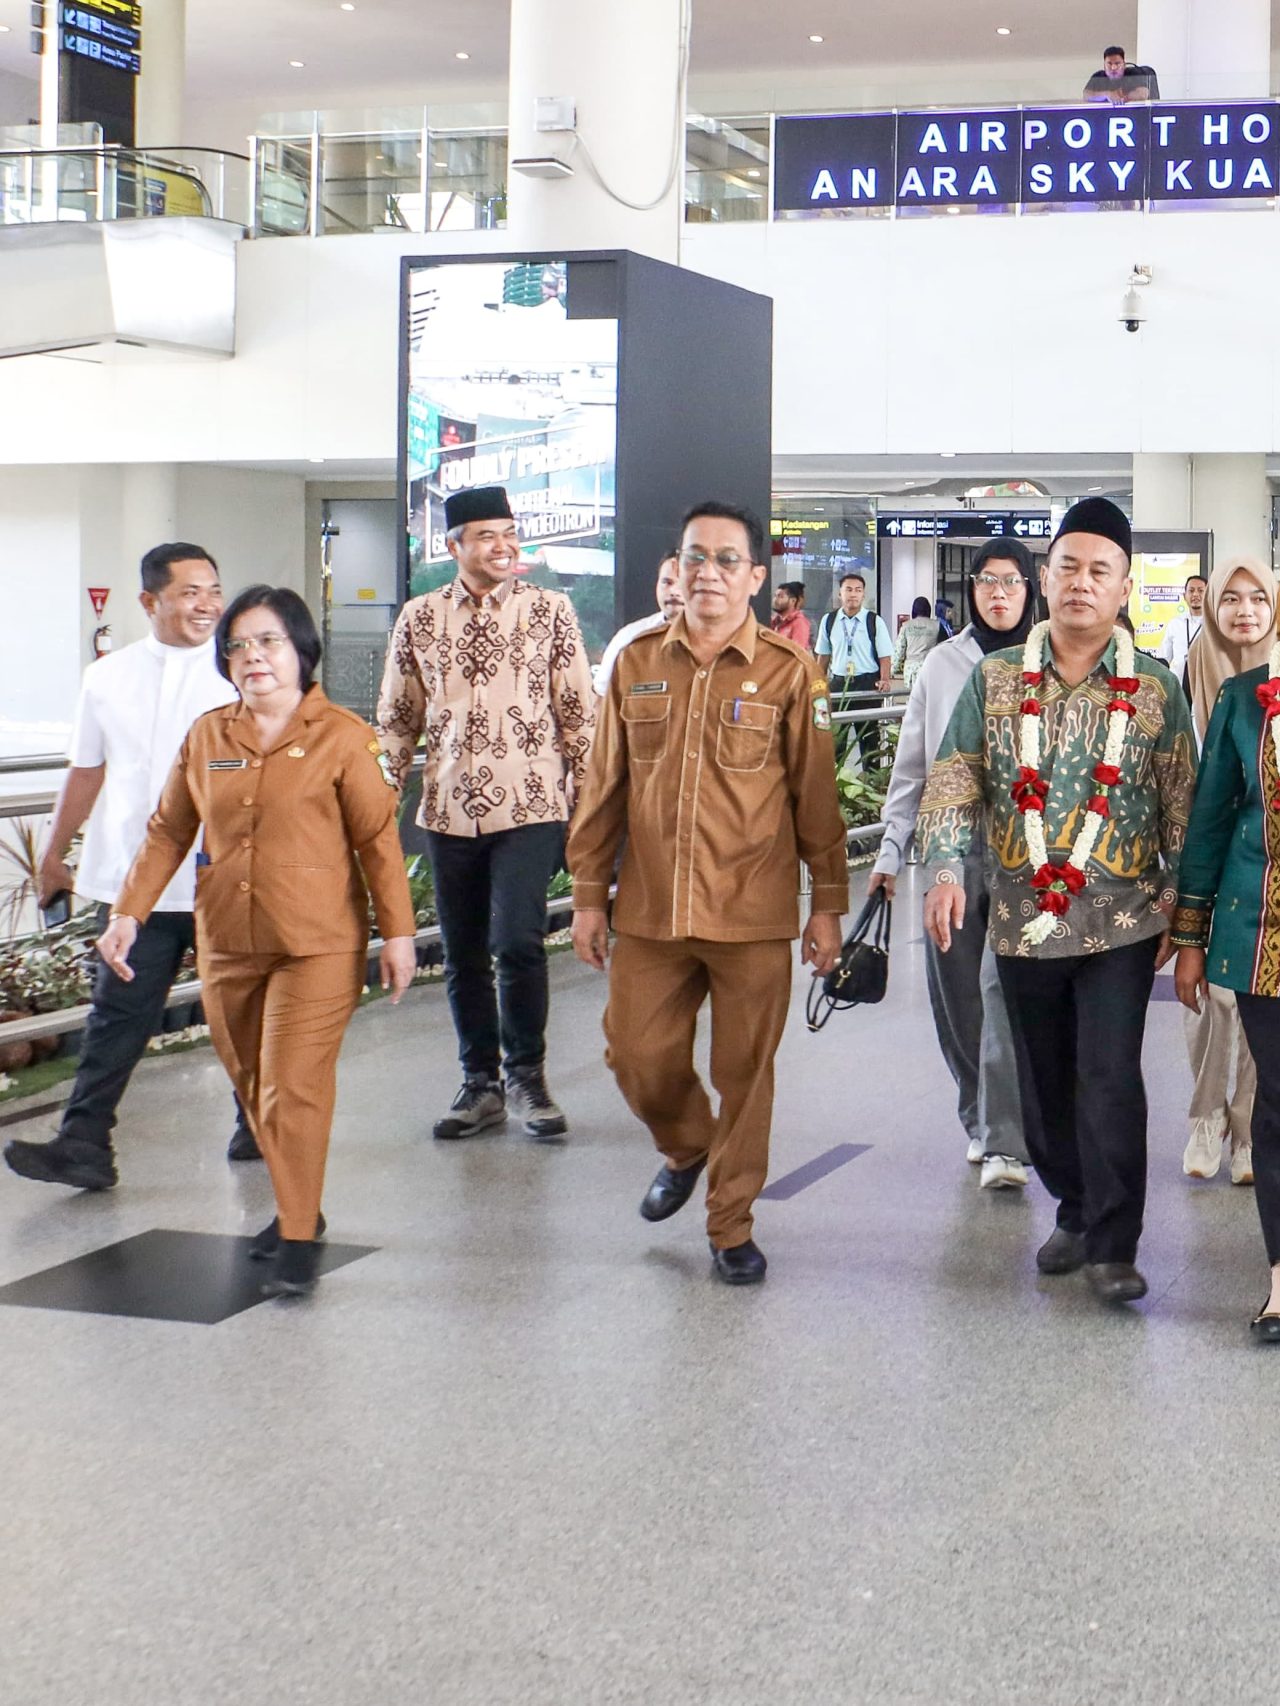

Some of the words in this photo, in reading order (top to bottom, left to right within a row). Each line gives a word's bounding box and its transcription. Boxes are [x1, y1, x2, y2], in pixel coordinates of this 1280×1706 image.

[919, 116, 1175, 153] AIRPORT
[811, 165, 997, 199] ANARA
[1030, 160, 1135, 194] SKY
[521, 508, 593, 538] VIDEOTRON
[783, 520, 829, 530] Kedatangan
